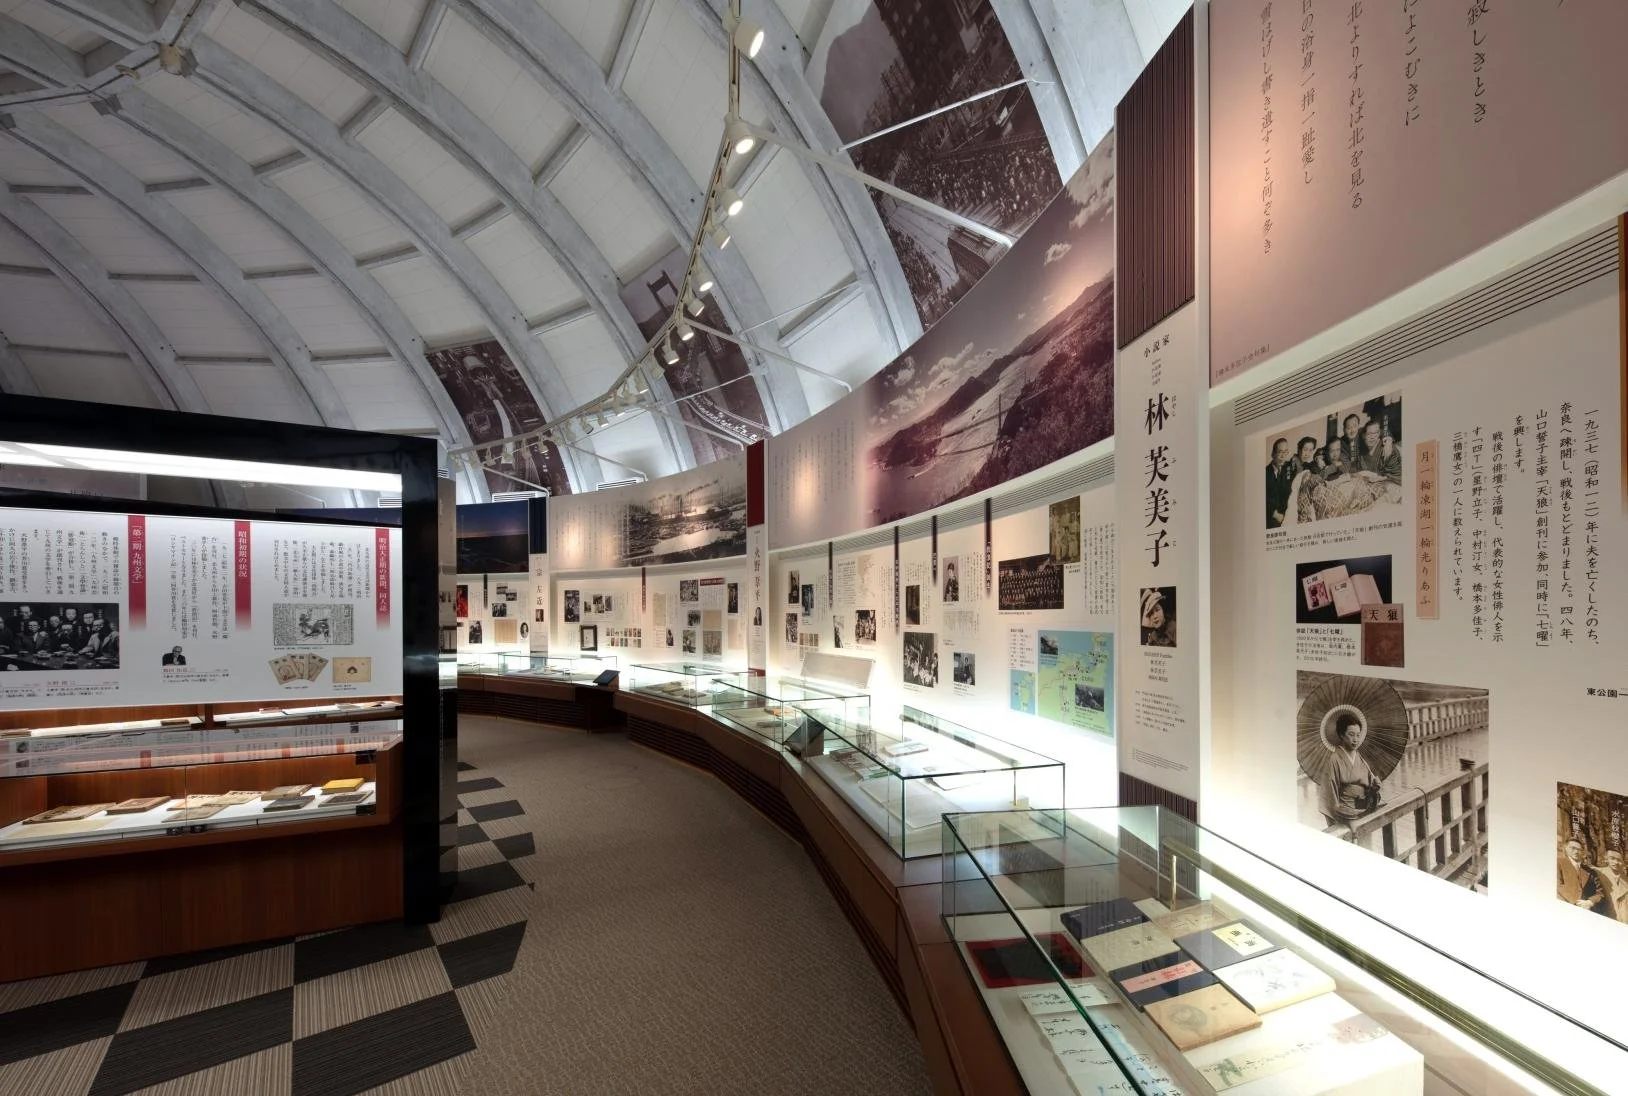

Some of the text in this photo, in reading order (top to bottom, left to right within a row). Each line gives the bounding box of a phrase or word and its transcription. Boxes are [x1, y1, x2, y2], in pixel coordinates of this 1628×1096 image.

[1346, 1, 1365, 208] 北よりすれば北を見る
[1144, 392, 1170, 568] 林芙美子
[1513, 415, 1525, 473] を興します。
[1369, 608, 1398, 621] 天狼
